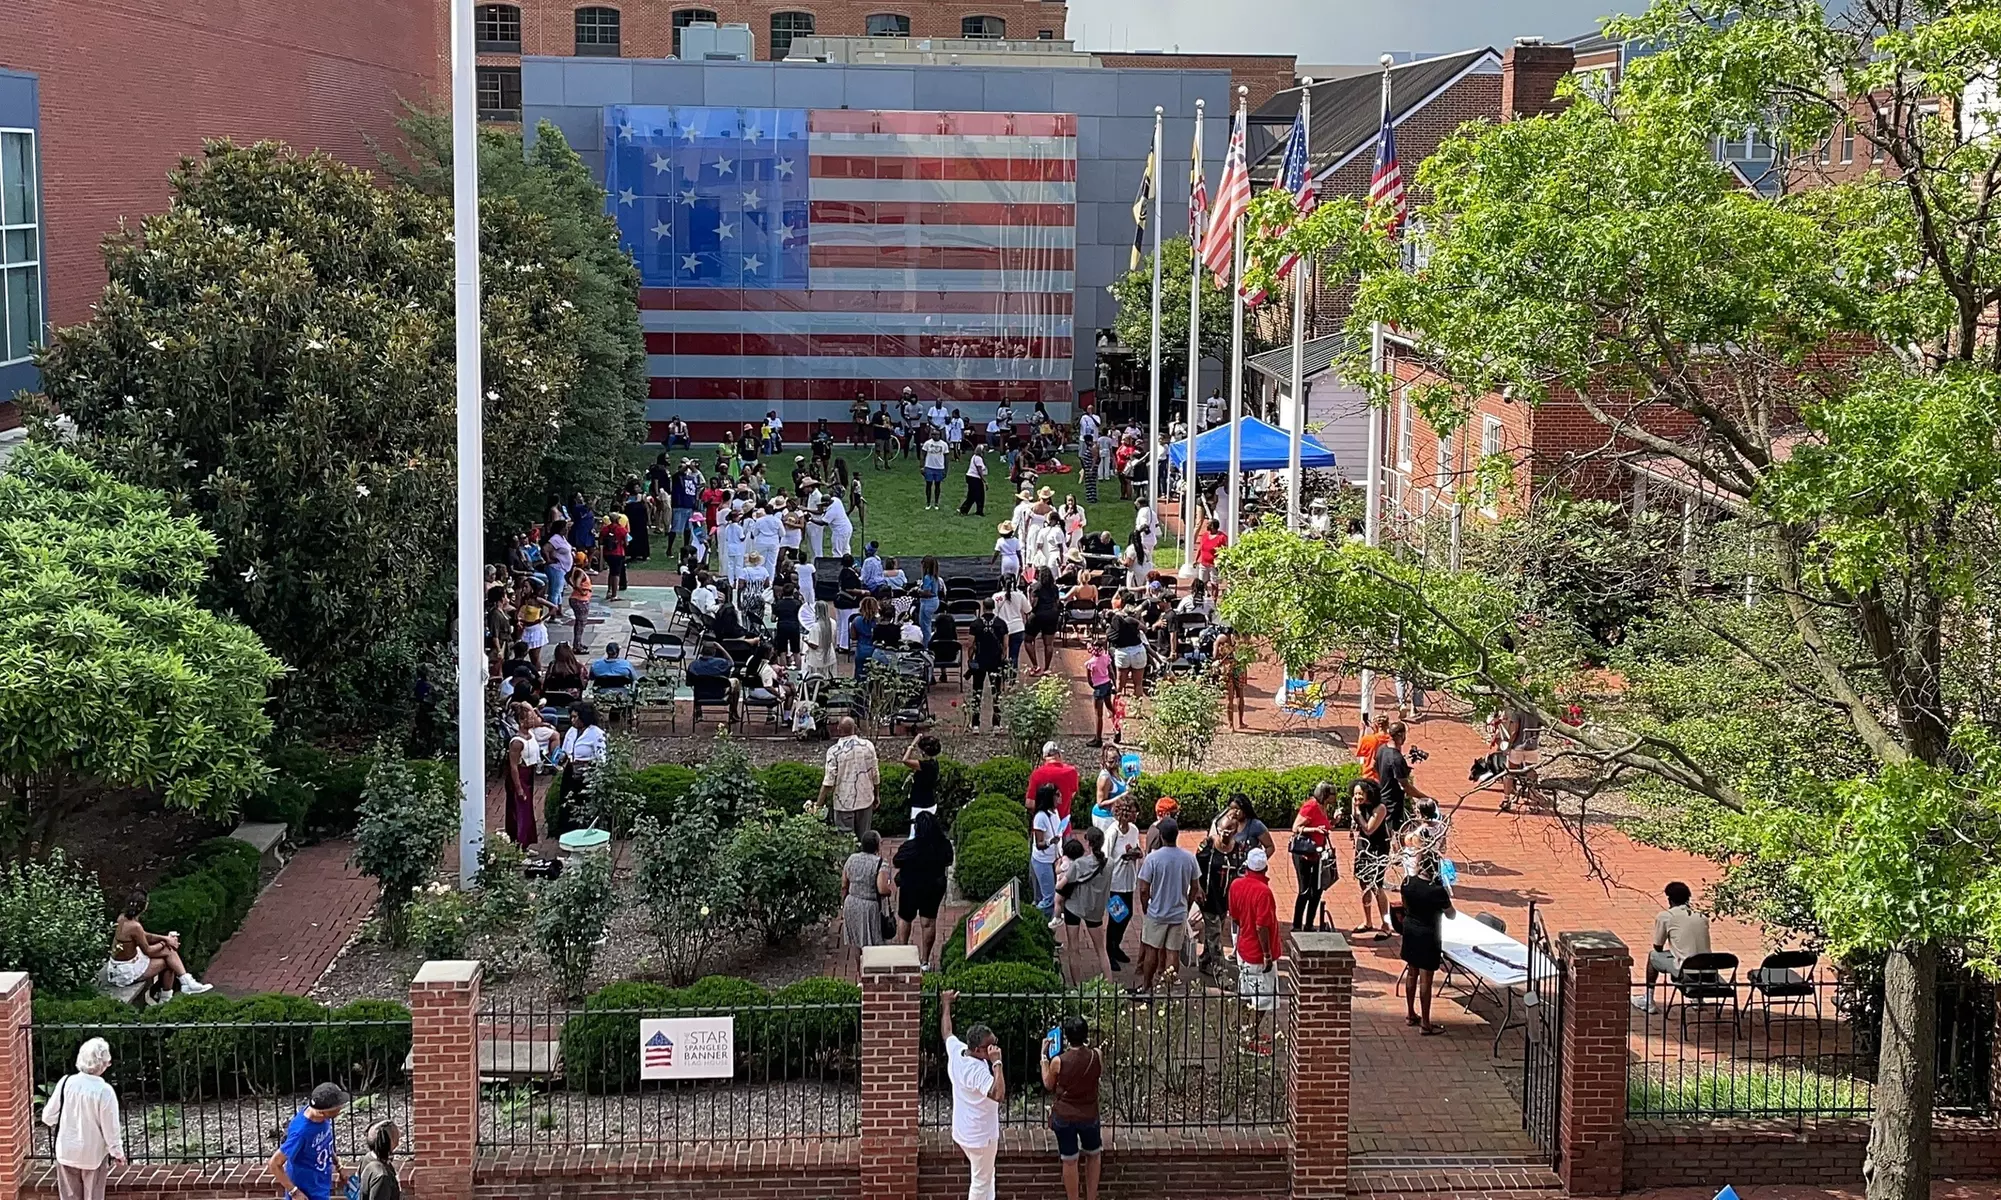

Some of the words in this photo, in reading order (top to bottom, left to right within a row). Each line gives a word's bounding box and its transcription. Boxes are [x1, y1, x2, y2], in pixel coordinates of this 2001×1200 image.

[690, 1031, 728, 1045] STAR
[684, 1044, 728, 1052] SPANGLED
[684, 1051, 728, 1060] BANNER
